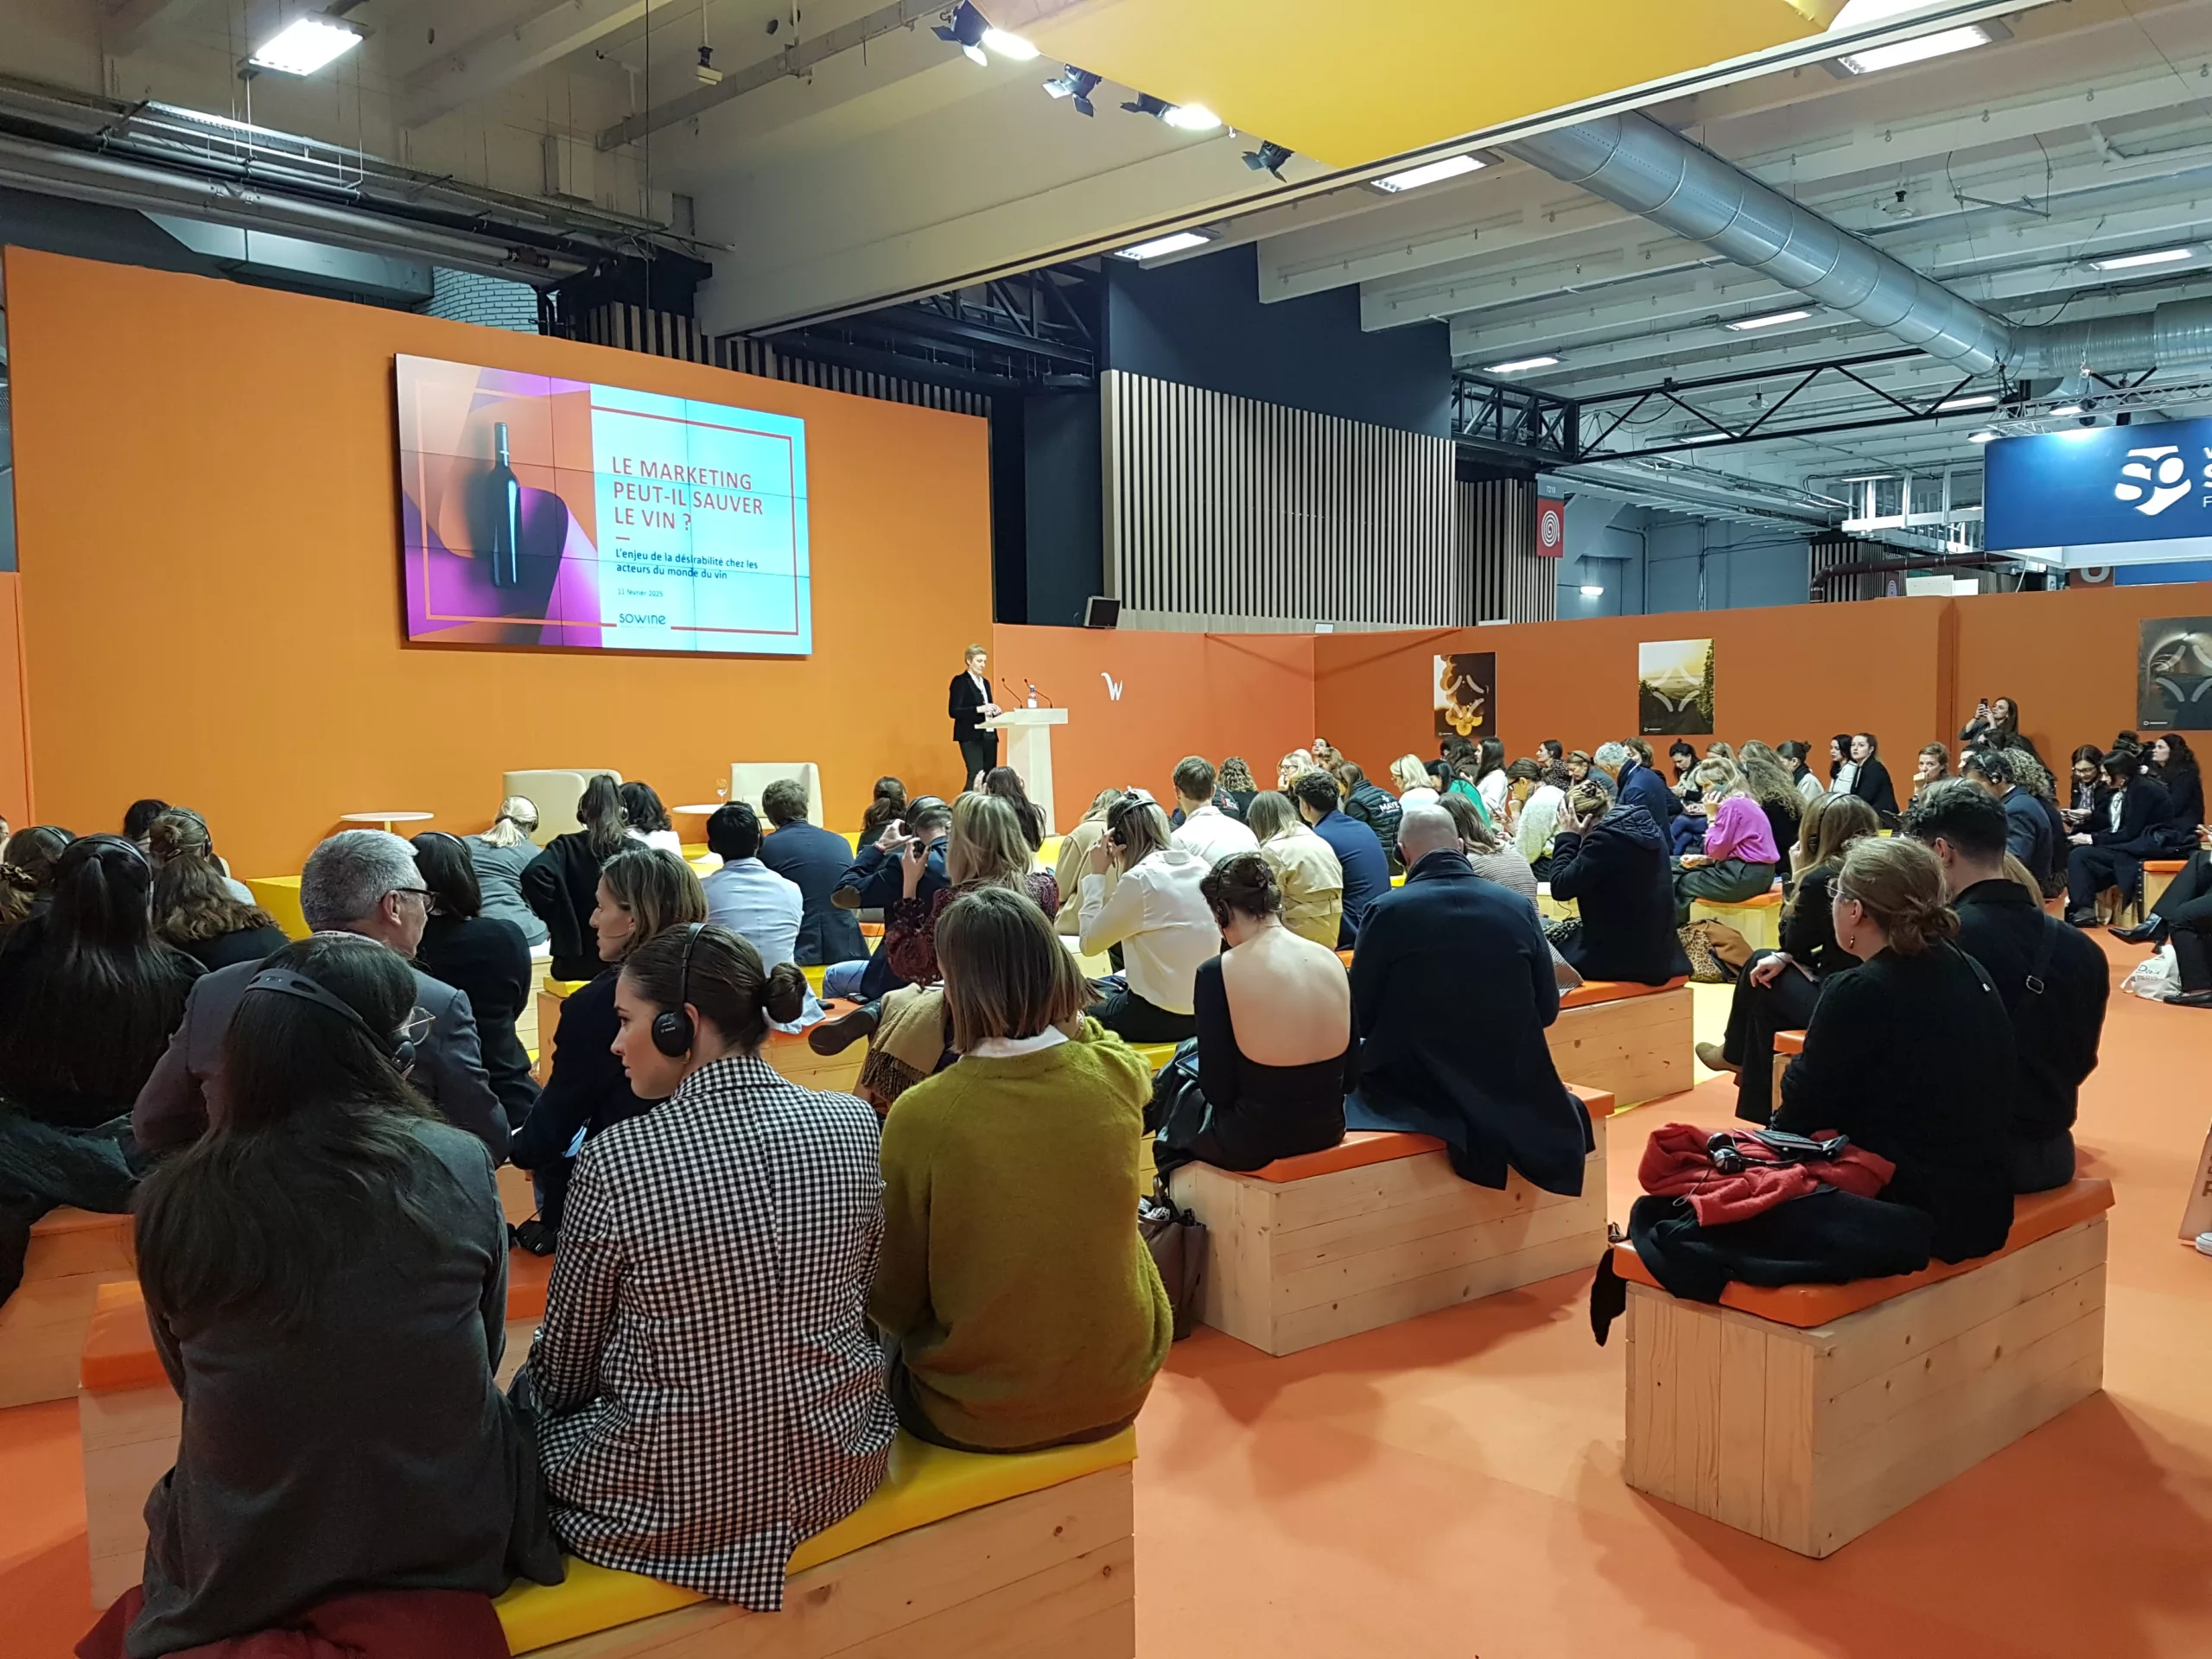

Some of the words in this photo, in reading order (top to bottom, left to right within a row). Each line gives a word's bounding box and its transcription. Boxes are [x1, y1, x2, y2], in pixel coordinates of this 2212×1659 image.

[613, 456, 632, 475] LE
[640, 460, 752, 491] MARKETING
[613, 481, 687, 506] PEUT-IL
[693, 491, 763, 515] SAUVER
[614, 506, 635, 525] LE
[641, 509, 676, 530] VIN
[683, 512, 691, 531] ?
[615, 548, 648, 562] L'enjeu
[651, 551, 662, 562] de
[664, 552, 673, 562] la
[675, 553, 724, 567] désirabilité
[726, 558, 744, 569] chez
[747, 560, 759, 569] les
[616, 564, 651, 575] acteurs
[652, 565, 664, 575] du
[667, 568, 699, 578] monde
[701, 569, 713, 579] du
[715, 570, 728, 580] vin
[626, 588, 647, 597] février
